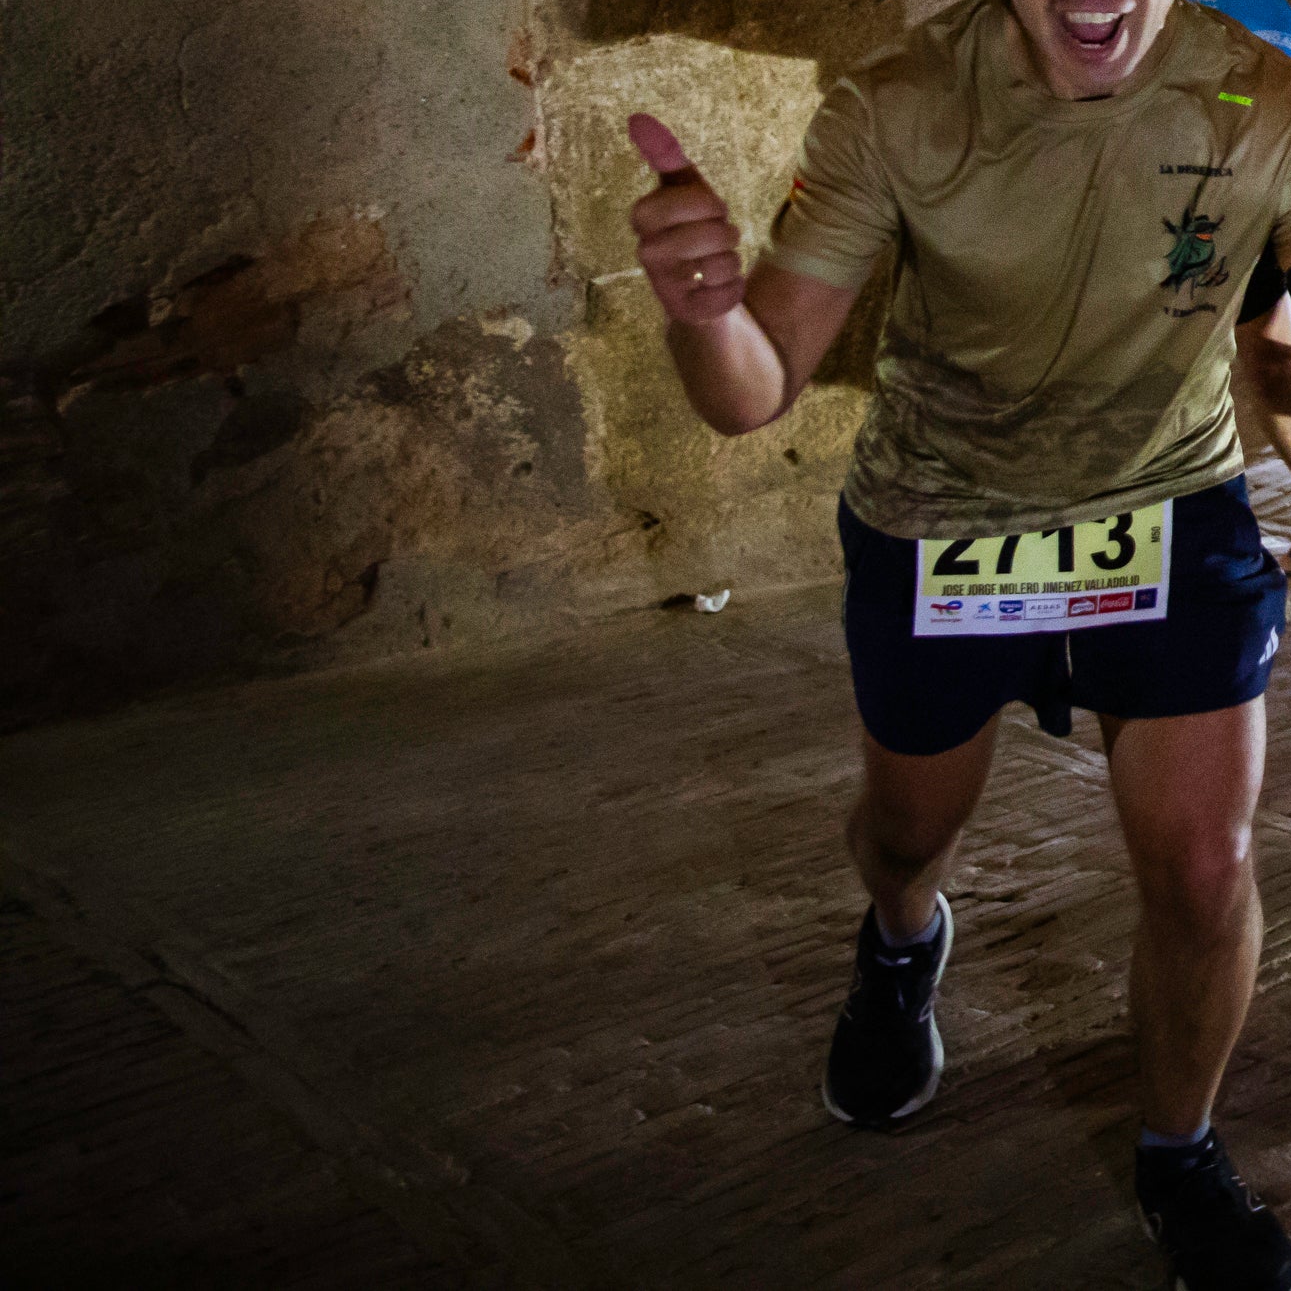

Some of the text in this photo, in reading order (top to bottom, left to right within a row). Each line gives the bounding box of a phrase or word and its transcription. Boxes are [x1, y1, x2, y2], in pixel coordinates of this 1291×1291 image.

[932, 511, 1136, 576] 2713
[941, 584, 965, 597] JOSE
[967, 583, 996, 596] JORGE
[999, 581, 1039, 595] MOLERO
[1041, 578, 1082, 594] JIMENEZ
